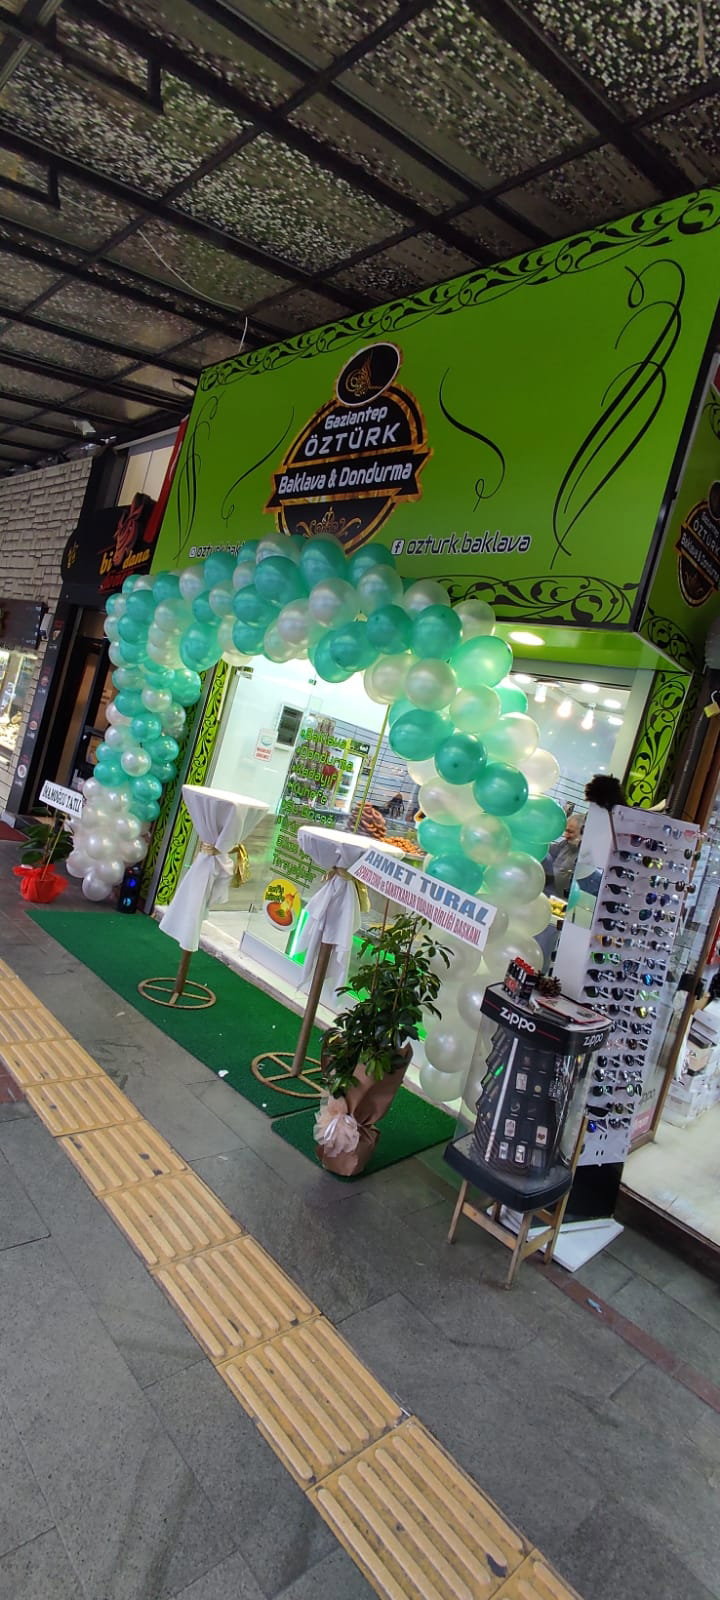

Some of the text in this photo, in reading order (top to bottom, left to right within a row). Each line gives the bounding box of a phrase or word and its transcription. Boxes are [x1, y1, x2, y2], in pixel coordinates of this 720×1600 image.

[324, 405, 388, 431] Gaziantep
[304, 422, 401, 458] ÖZTÜRK
[278, 461, 413, 495] Baklava & Dondurma
[406, 532, 532, 556] ozturk.baklava
[365, 850, 417, 886] AHMET
[420, 876, 489, 926] TURAL
